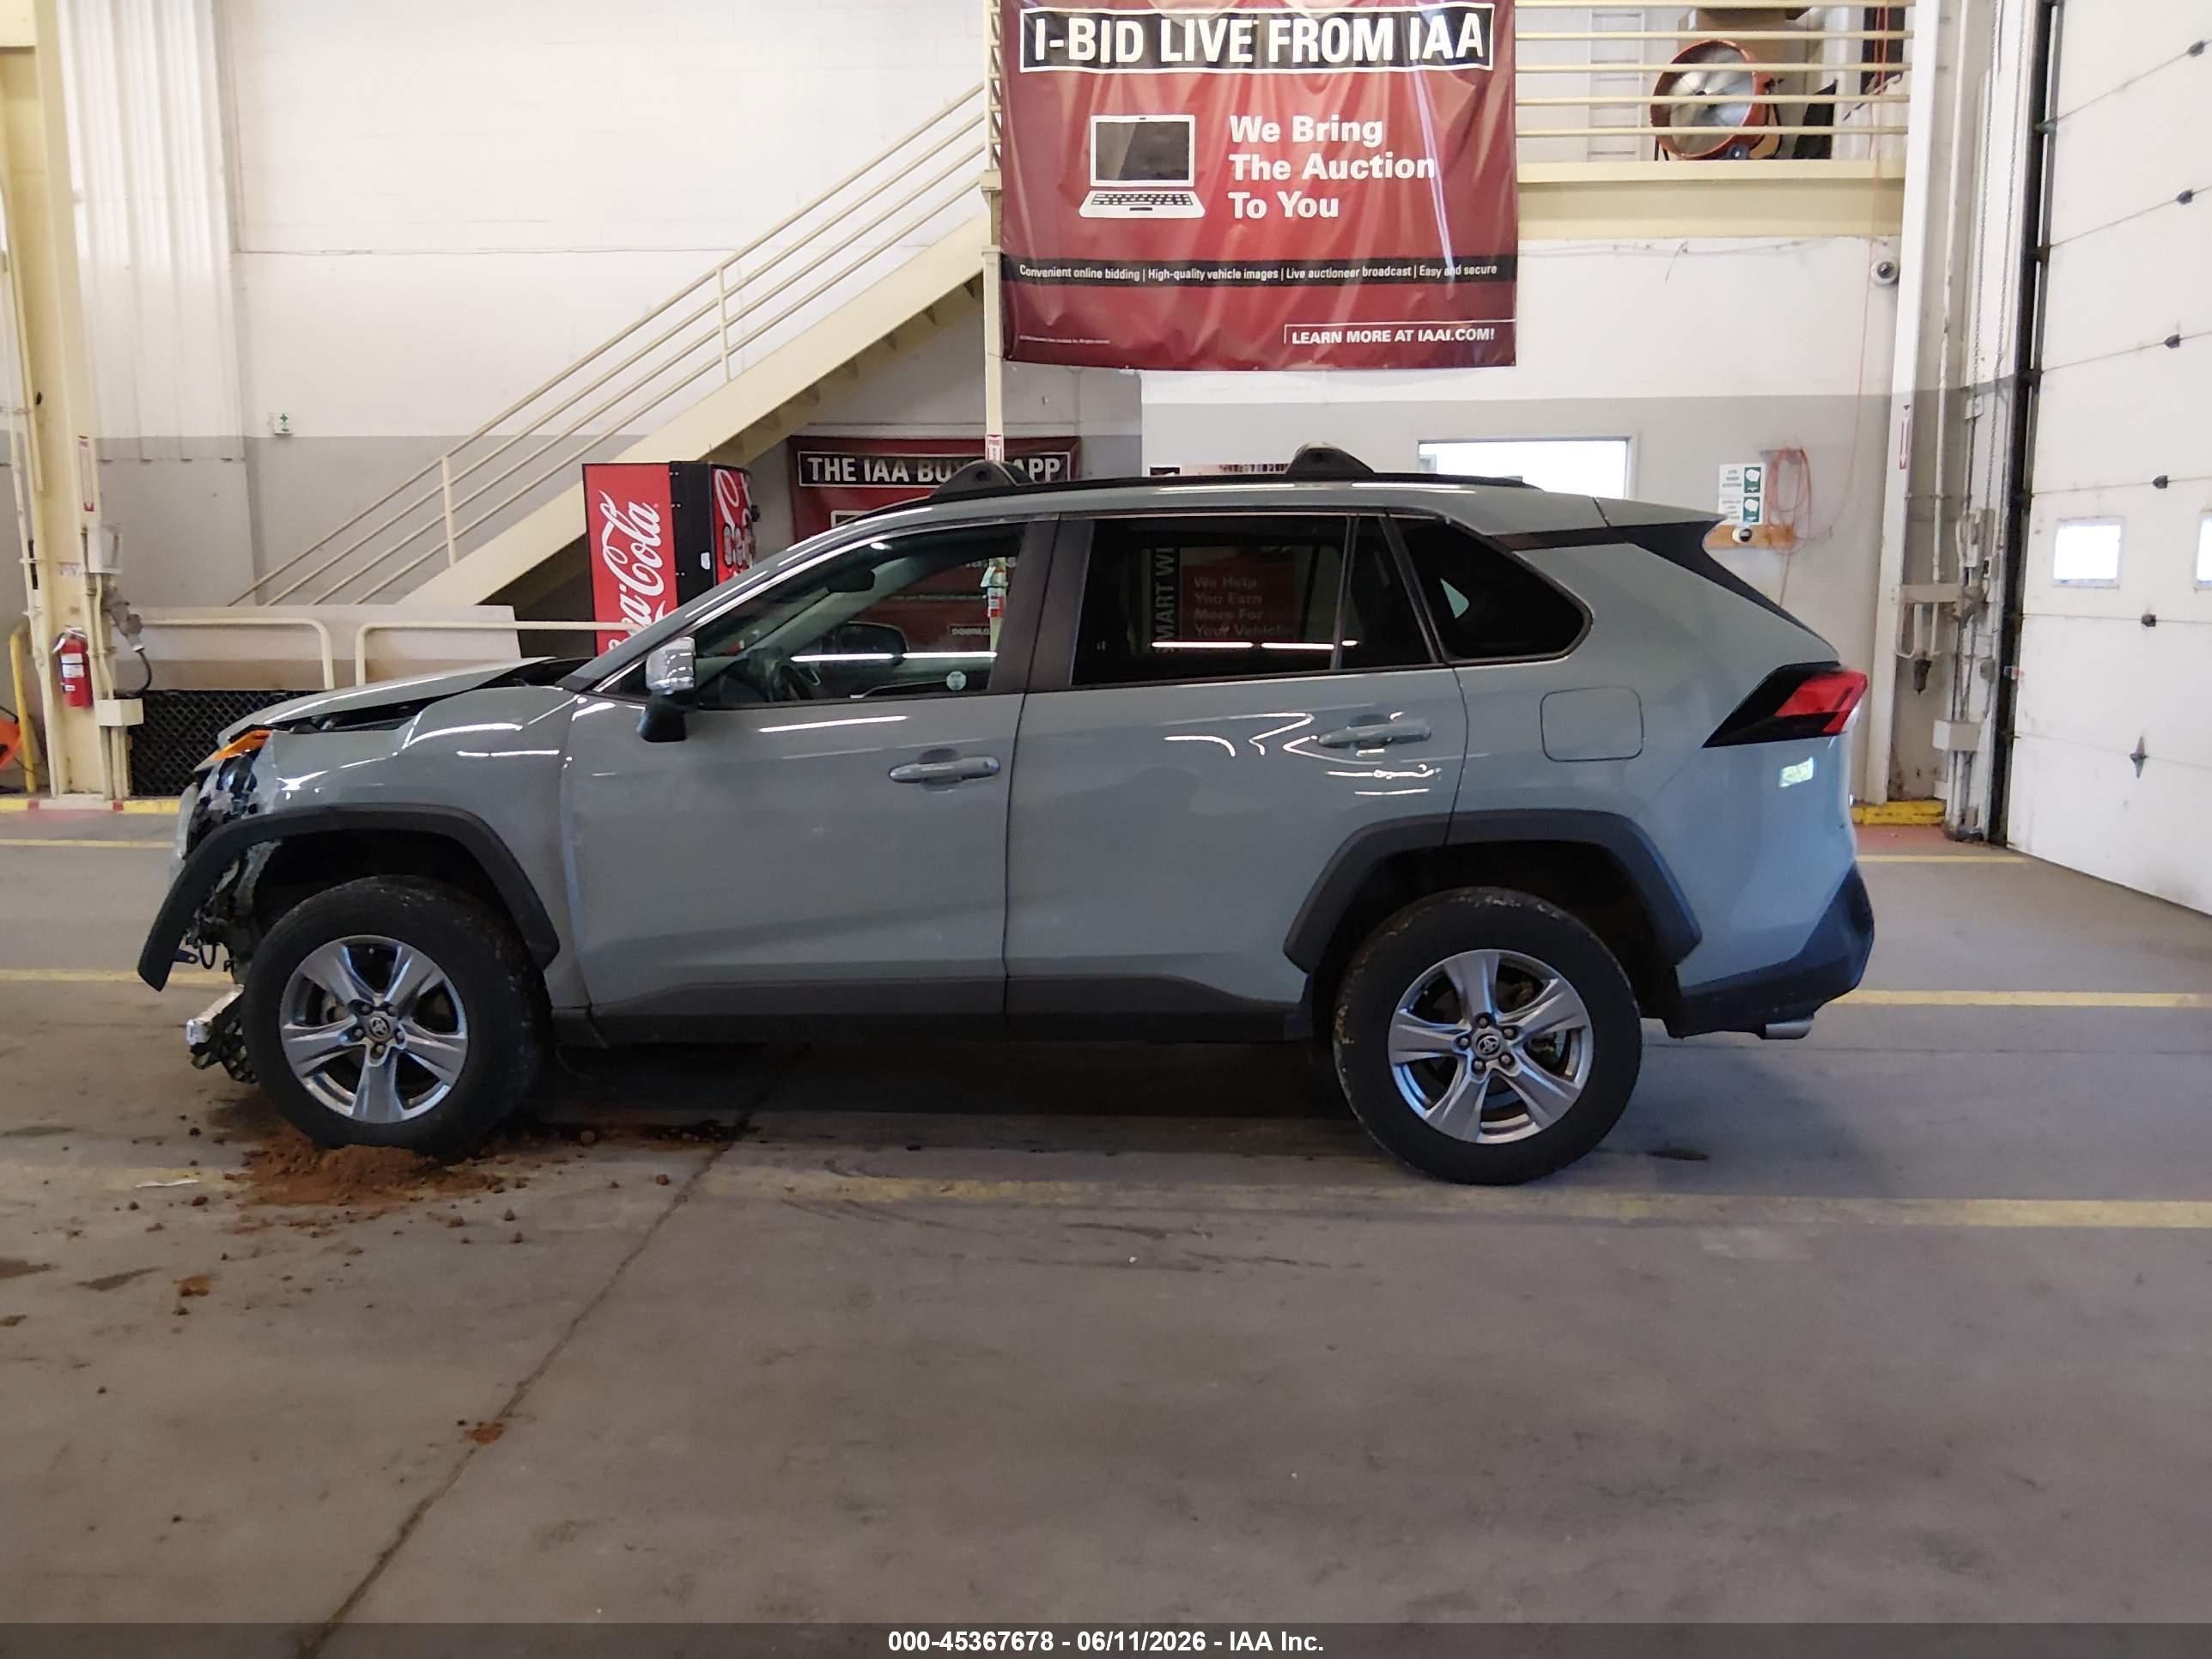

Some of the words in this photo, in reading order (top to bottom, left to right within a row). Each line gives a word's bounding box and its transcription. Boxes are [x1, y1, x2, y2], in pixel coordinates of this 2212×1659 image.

[1035, 17, 1144, 63] I-BID
[1160, 18, 1253, 63] LIVE
[1268, 17, 1394, 63] FROM
[1409, 12, 1484, 61] IAA
[1229, 115, 1280, 143] We
[1292, 114, 1382, 148] Bring
[1228, 154, 1291, 181] The
[1301, 151, 1435, 179] Auction
[1227, 191, 1267, 219] To
[1276, 191, 1339, 218] You
[1019, 264, 1072, 278] Convenient
[1073, 267, 1103, 279] online
[1104, 268, 1140, 282] bidding
[1148, 268, 1205, 282] High-quality
[1207, 268, 1242, 279] vehicle
[1243, 268, 1279, 282] images
[1286, 268, 1305, 279] Live
[1308, 267, 1360, 279] auctioneer
[1362, 265, 1412, 277] broadcast
[1419, 264, 1443, 279] Easy
[1443, 264, 1462, 276] and
[1463, 264, 1498, 276] secure
[1291, 331, 1342, 344] LEARN
[1346, 330, 1391, 343] MORE
[1395, 329, 1414, 342] AT
[1418, 328, 1495, 342] IAAI.COM!
[807, 457, 857, 482] THE
[864, 459, 910, 483] IAA
